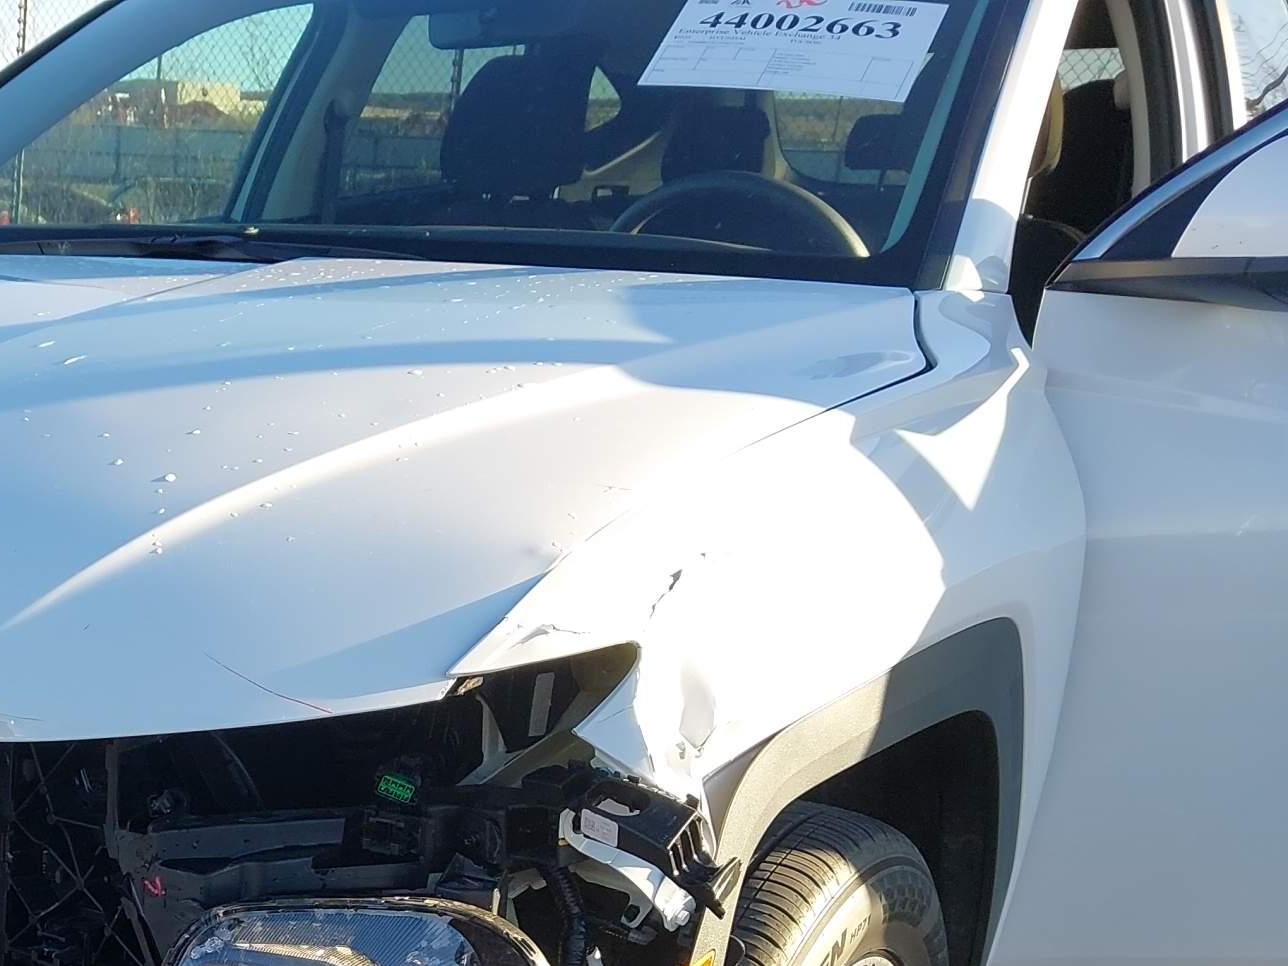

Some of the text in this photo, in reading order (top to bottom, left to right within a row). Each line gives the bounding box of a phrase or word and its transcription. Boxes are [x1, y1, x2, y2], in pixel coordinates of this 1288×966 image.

[678, 28, 730, 36] Enterprise
[733, 29, 773, 37] Vehicle
[774, 31, 824, 40] Exchange
[699, 11, 902, 39] 44002663
